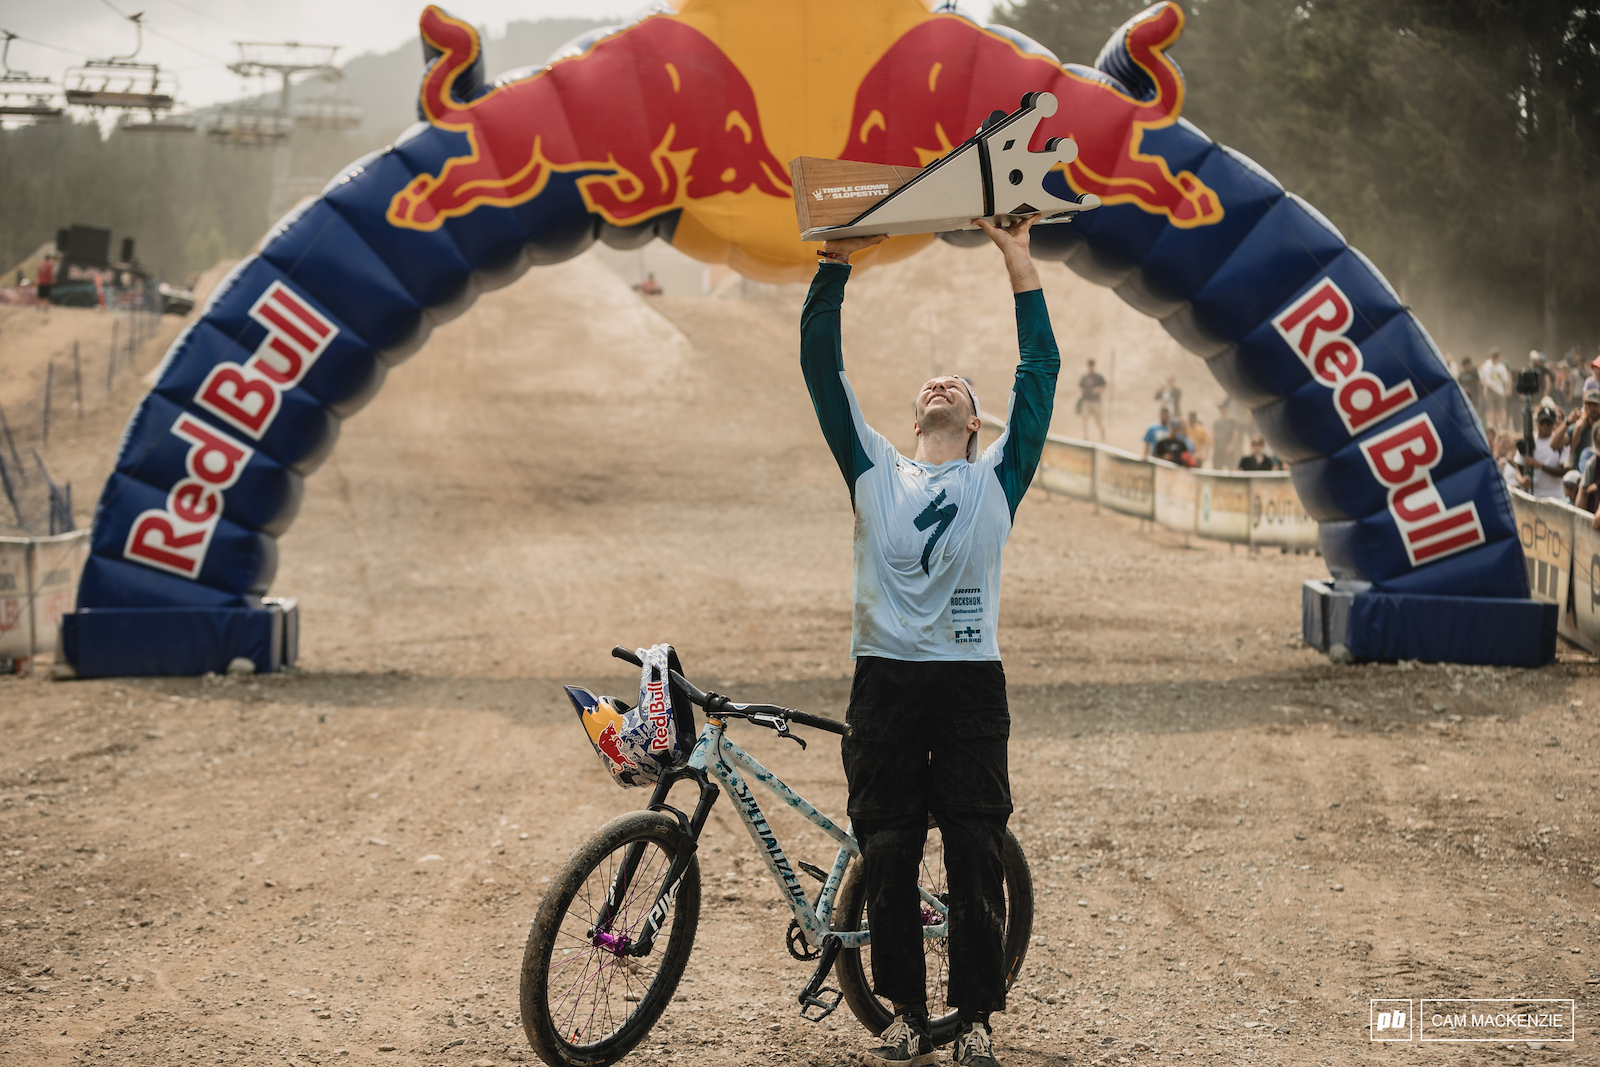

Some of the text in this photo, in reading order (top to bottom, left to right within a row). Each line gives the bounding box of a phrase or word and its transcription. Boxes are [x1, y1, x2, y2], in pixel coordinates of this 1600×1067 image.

[822, 183, 889, 194] TRIPLE CROWN
[832, 189, 889, 199] SLOPESTYLE
[127, 284, 333, 575] Red Bull
[1277, 281, 1482, 564] Red Bull
[1518, 519, 1561, 559] oPro
[951, 597, 981, 606] ROCKSHOX
[647, 682, 668, 750] Red Bull
[735, 784, 805, 897] SPECIALIZED
